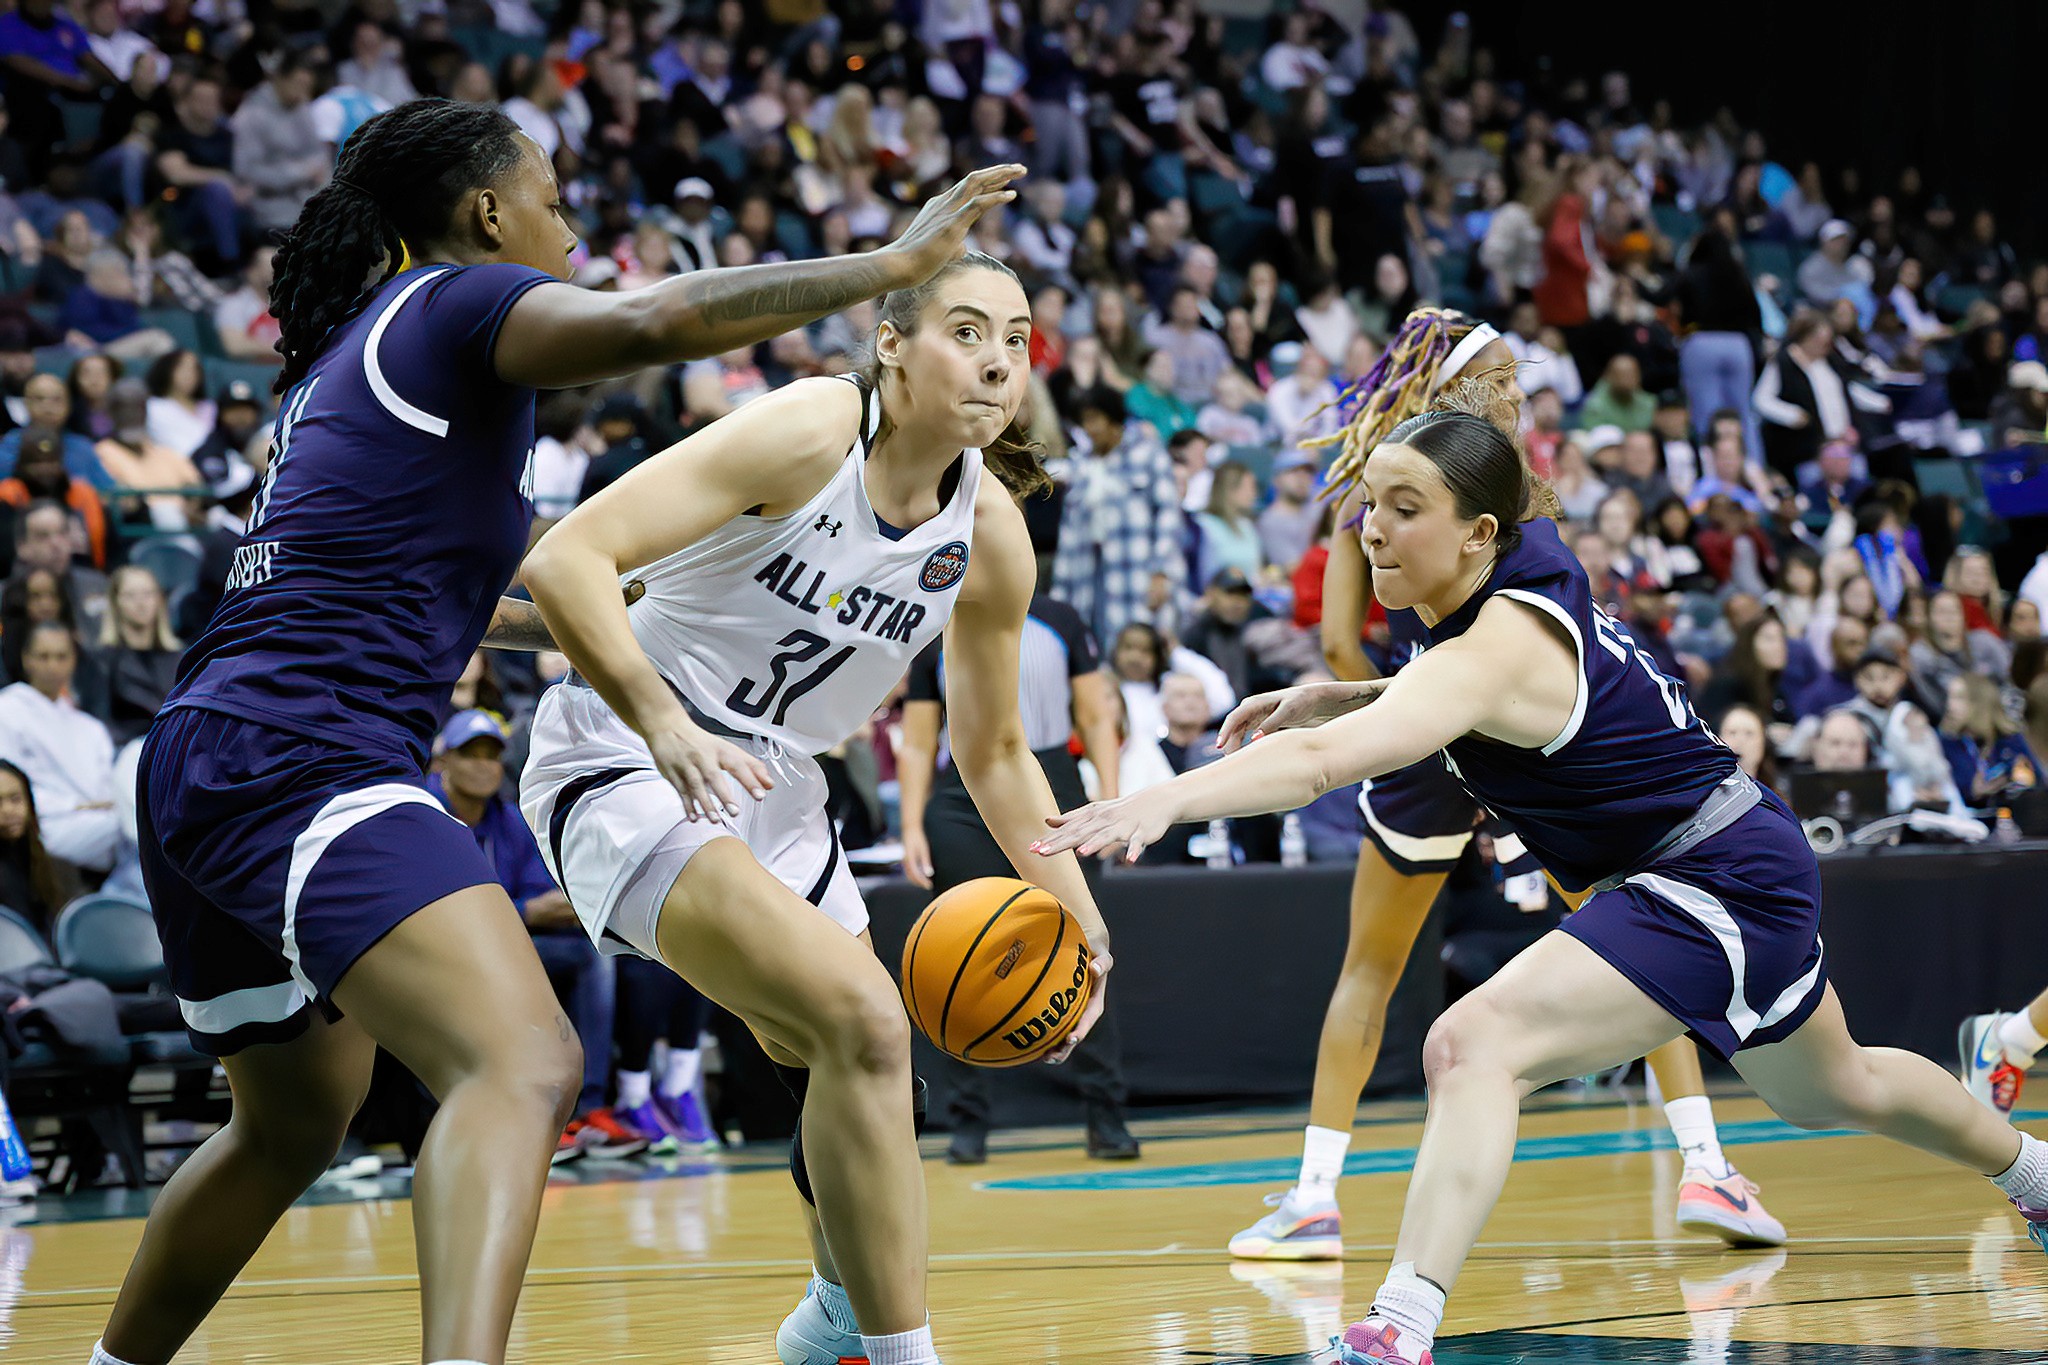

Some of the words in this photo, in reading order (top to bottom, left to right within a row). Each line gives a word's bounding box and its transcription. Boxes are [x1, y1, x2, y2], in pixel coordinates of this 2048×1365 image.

[754, 552, 826, 614] ALL
[837, 585, 926, 643] STAR
[726, 629, 857, 726] 31
[1002, 943, 1088, 1050] Wilson
